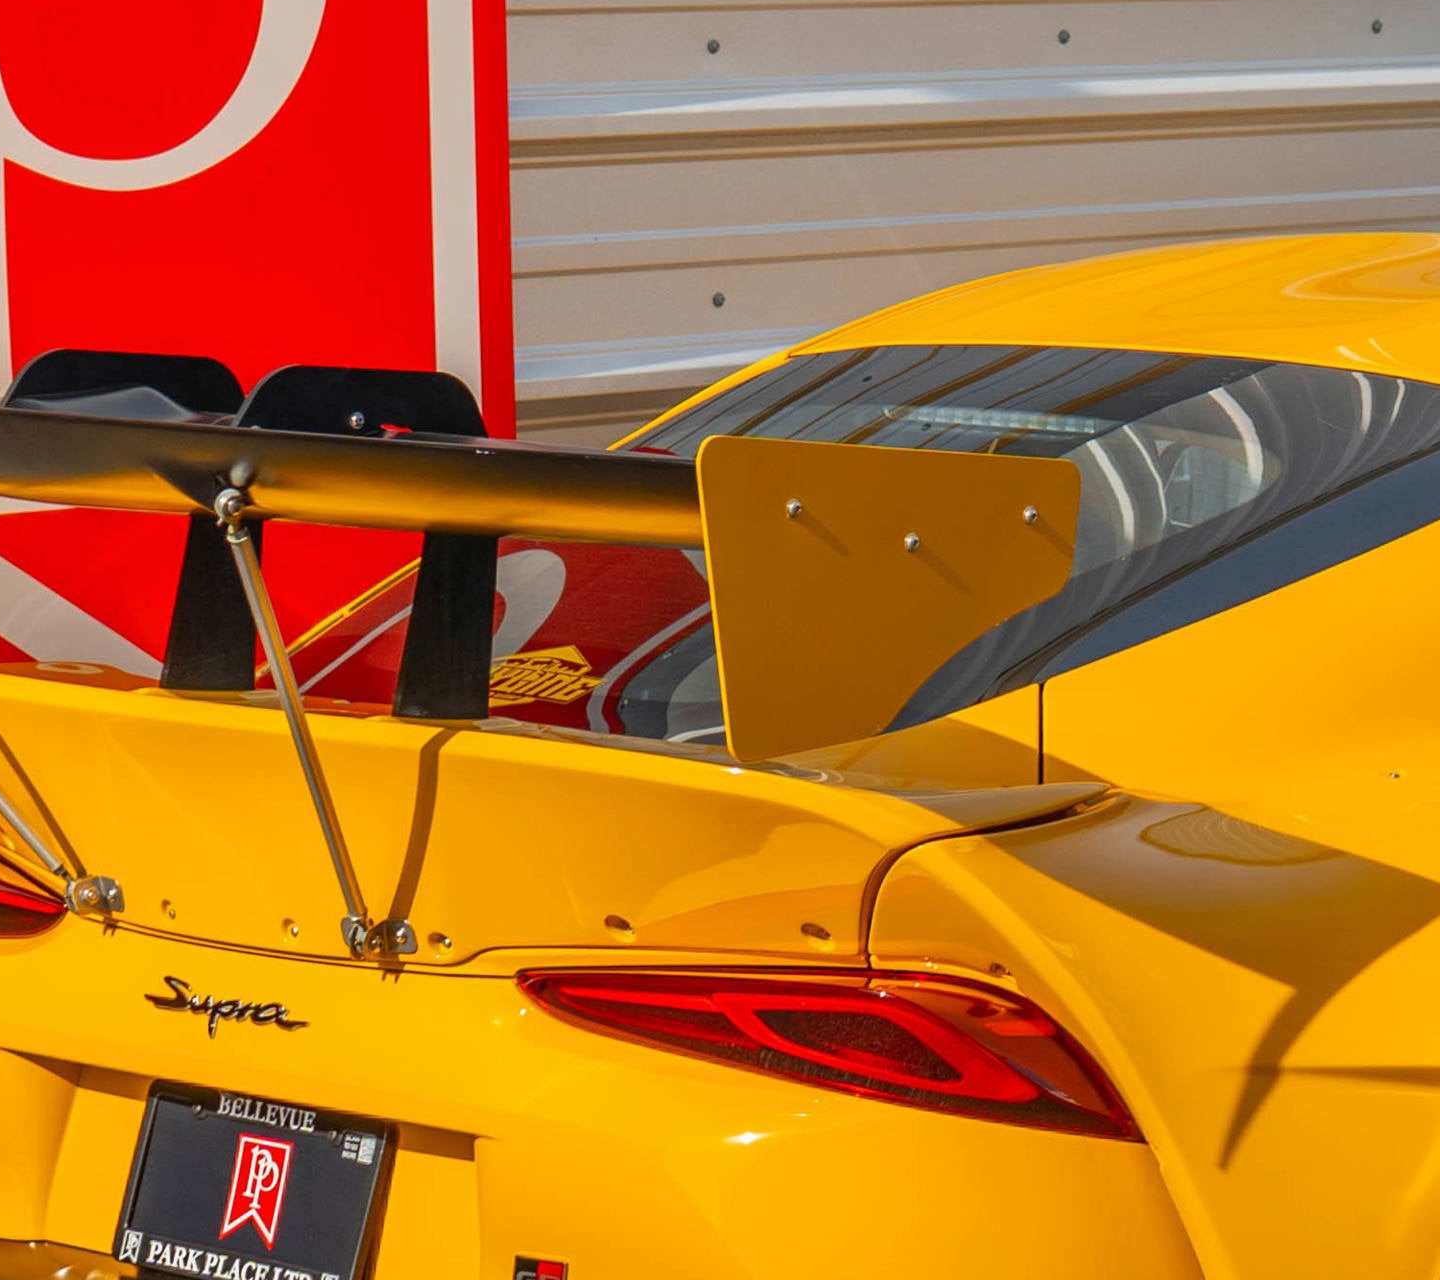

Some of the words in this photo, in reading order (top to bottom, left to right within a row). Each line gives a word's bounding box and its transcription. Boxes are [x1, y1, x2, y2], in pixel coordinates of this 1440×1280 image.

[144, 975, 310, 1040] Supra
[217, 1093, 317, 1132] BELLEVUE
[145, 1239, 204, 1272] PARK
